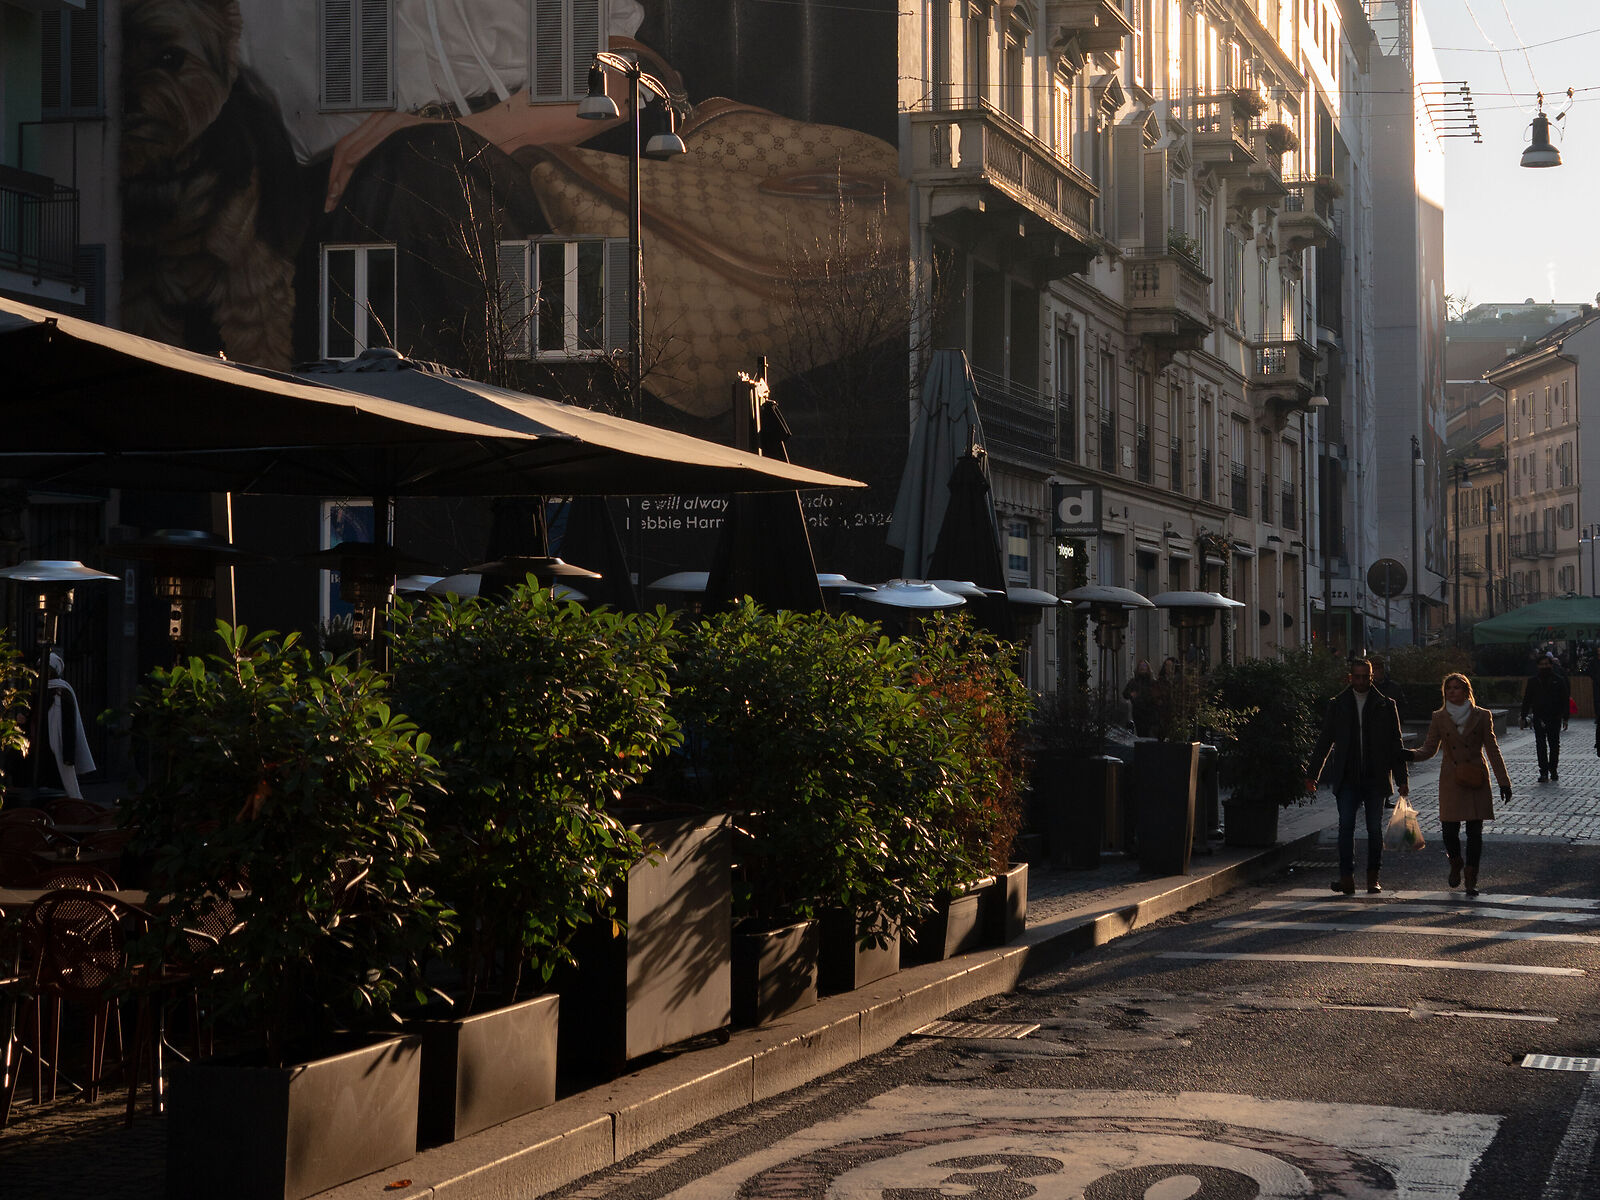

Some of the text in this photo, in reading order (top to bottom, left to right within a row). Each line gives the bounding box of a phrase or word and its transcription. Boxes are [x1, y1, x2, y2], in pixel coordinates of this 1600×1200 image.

[626, 497, 651, 510] e
[655, 496, 681, 510] will
[683, 496, 729, 513] alway
[1058, 490, 1094, 524] d
[686, 515, 725, 529] Harr
